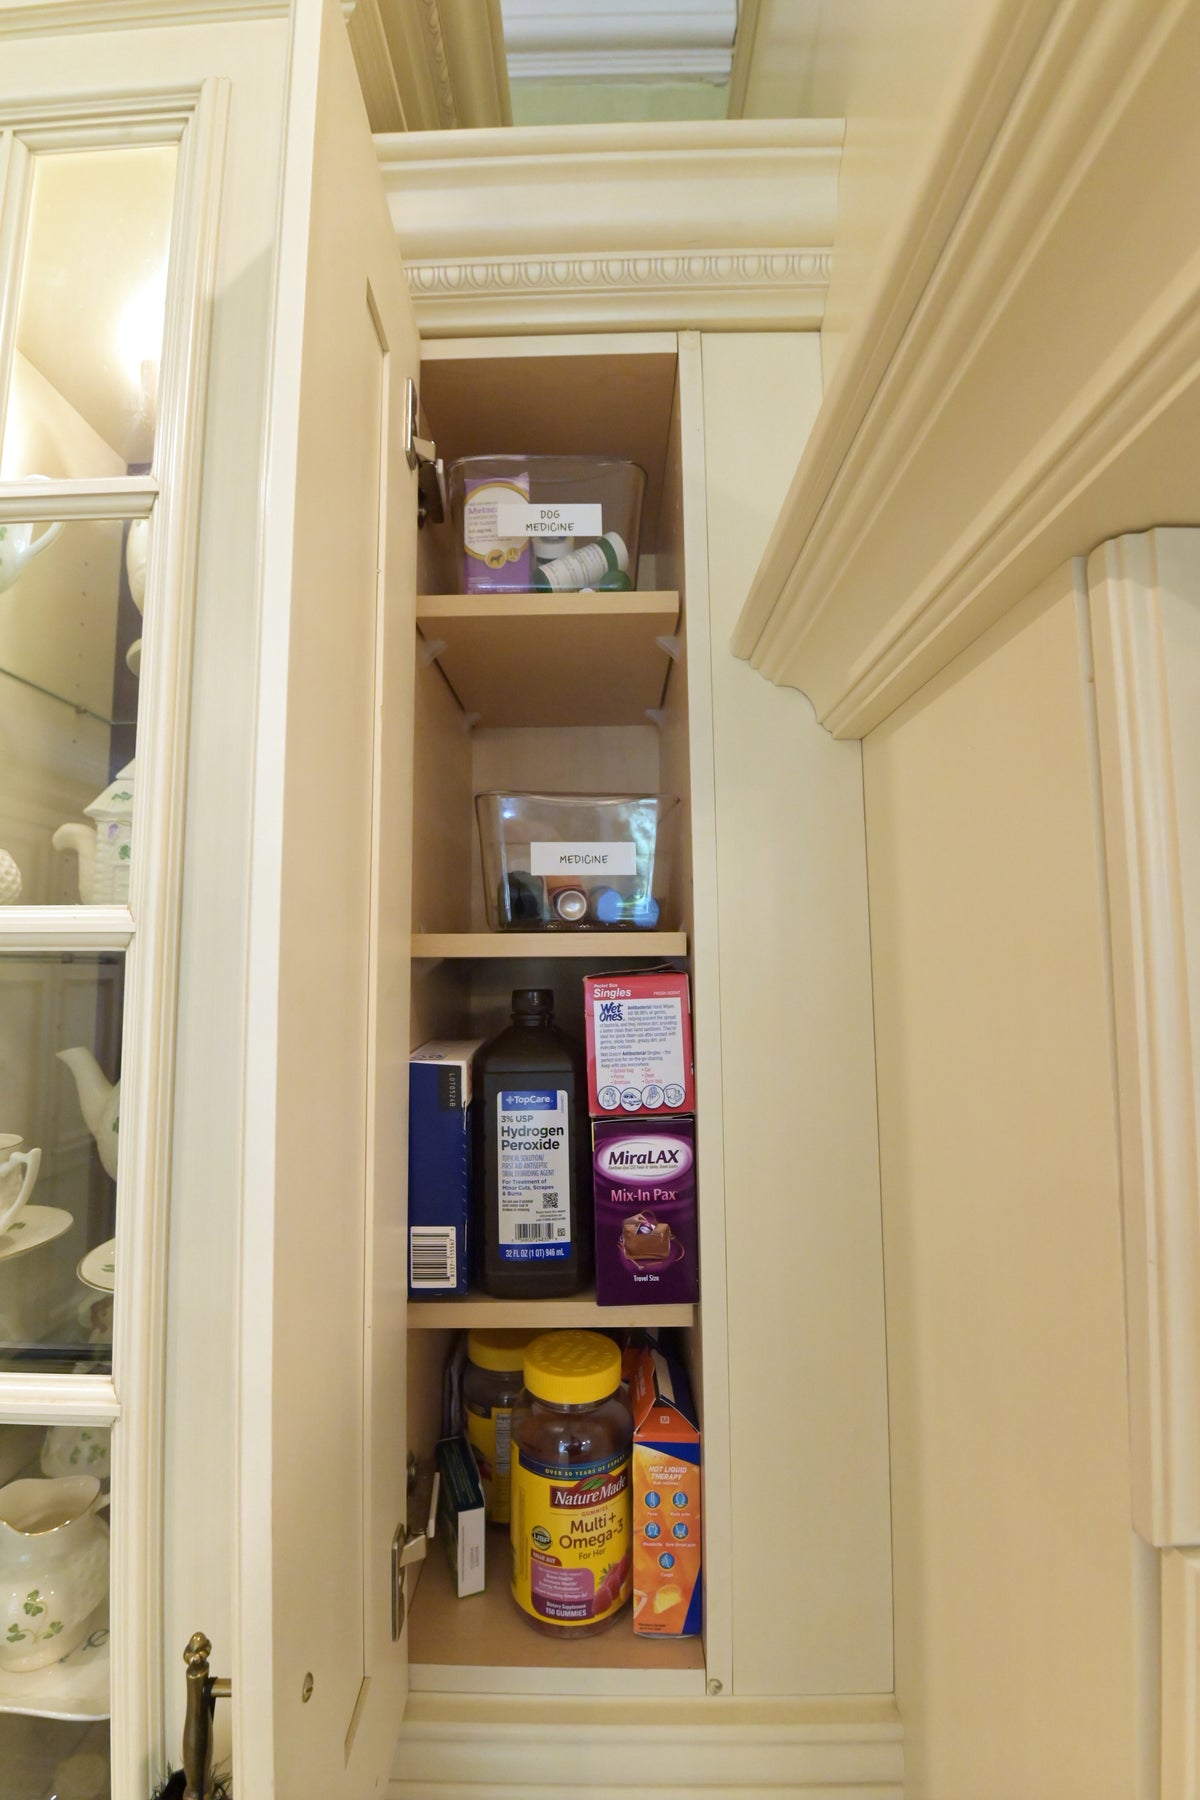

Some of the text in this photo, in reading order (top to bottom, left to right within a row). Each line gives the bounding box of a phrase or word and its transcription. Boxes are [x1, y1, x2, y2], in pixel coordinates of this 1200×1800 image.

[469, 507, 497, 515] Metac
[540, 510, 560, 519] DOG
[526, 522, 574, 532] MEDICINE
[559, 854, 609, 865] MEDICINE
[593, 988, 632, 999] Singles
[600, 1001, 624, 1014] Wet
[599, 1012, 623, 1023] Ones
[513, 1095, 551, 1106] TopCare
[501, 1114, 534, 1123] 3% USP
[501, 1125, 565, 1139] Hydrogen
[501, 1138, 560, 1151] Peroxide
[608, 1149, 680, 1166] MiraLAX
[610, 1188, 676, 1202] Mix-In Pax
[505, 1247, 565, 1259] 32 FL OZ (1 QT) 946 mL
[544, 1468, 562, 1476] OVER
[554, 1475, 627, 1505] Nature Made
[570, 1513, 607, 1534] Multi
[559, 1517, 624, 1549] Omega-3
[578, 1547, 606, 1560] For Her
[555, 1609, 587, 1617] GUMMIES
